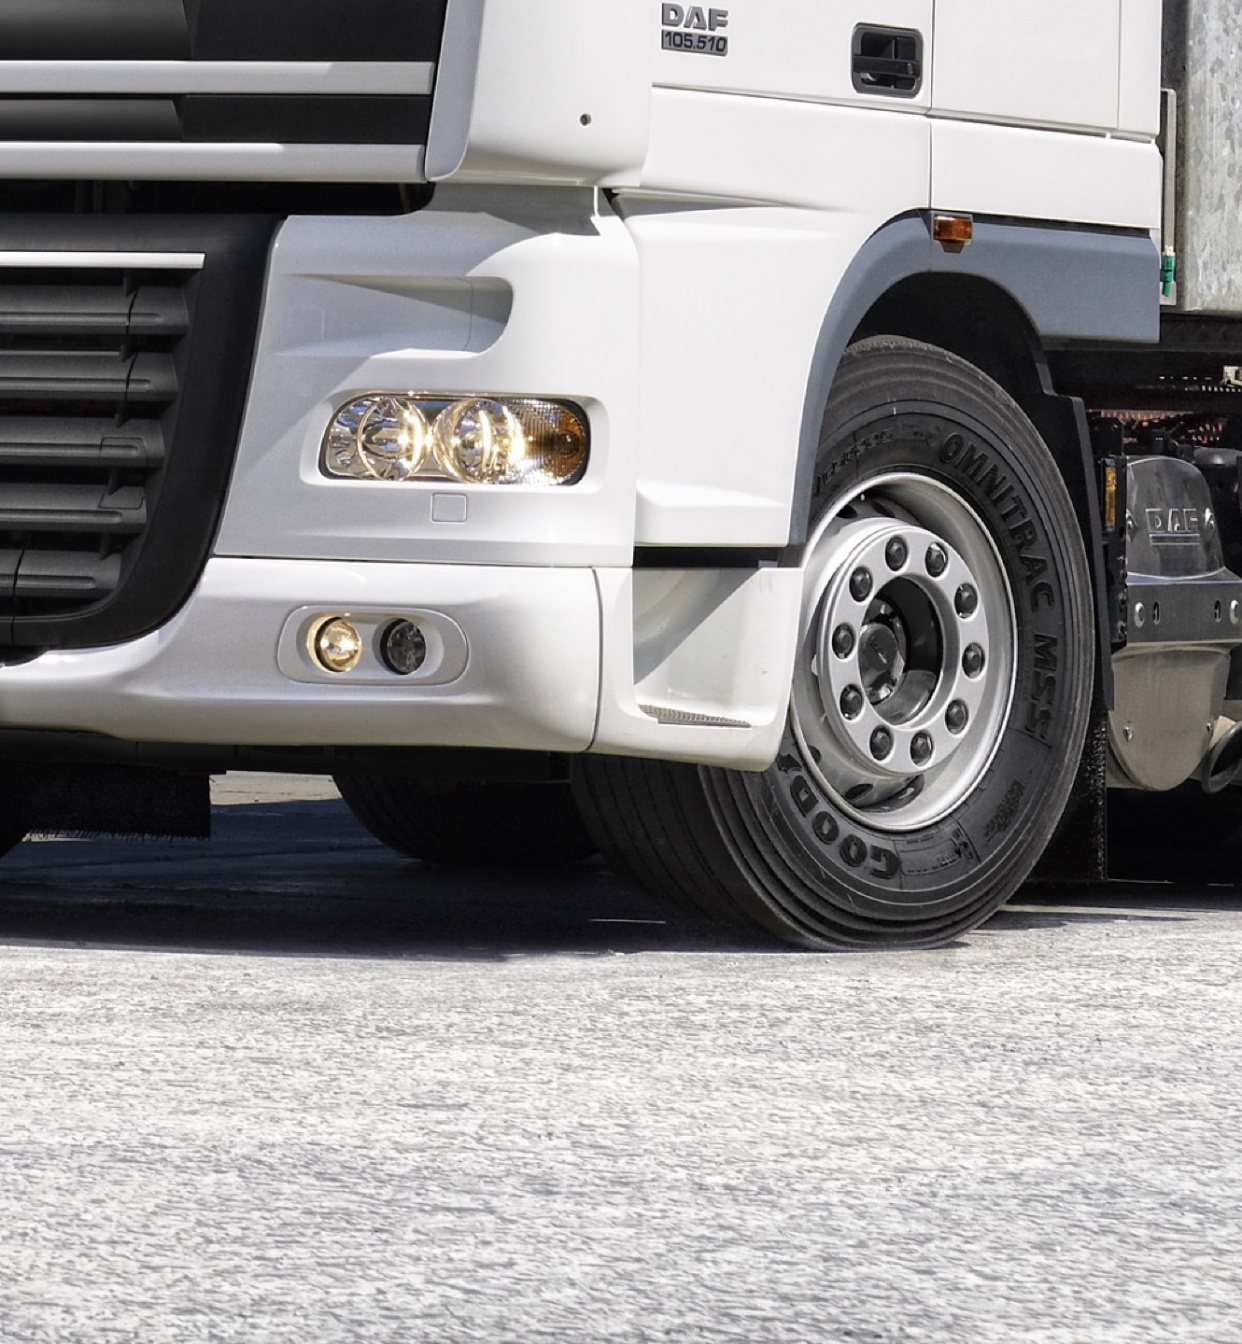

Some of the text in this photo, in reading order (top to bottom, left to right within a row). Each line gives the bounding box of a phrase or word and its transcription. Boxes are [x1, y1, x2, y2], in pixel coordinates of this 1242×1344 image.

[661, 2, 728, 31] DAF
[664, 31, 727, 53] 105.510
[1144, 507, 1198, 532] DAF
[940, 433, 1058, 740] OMNITRAC MSS
